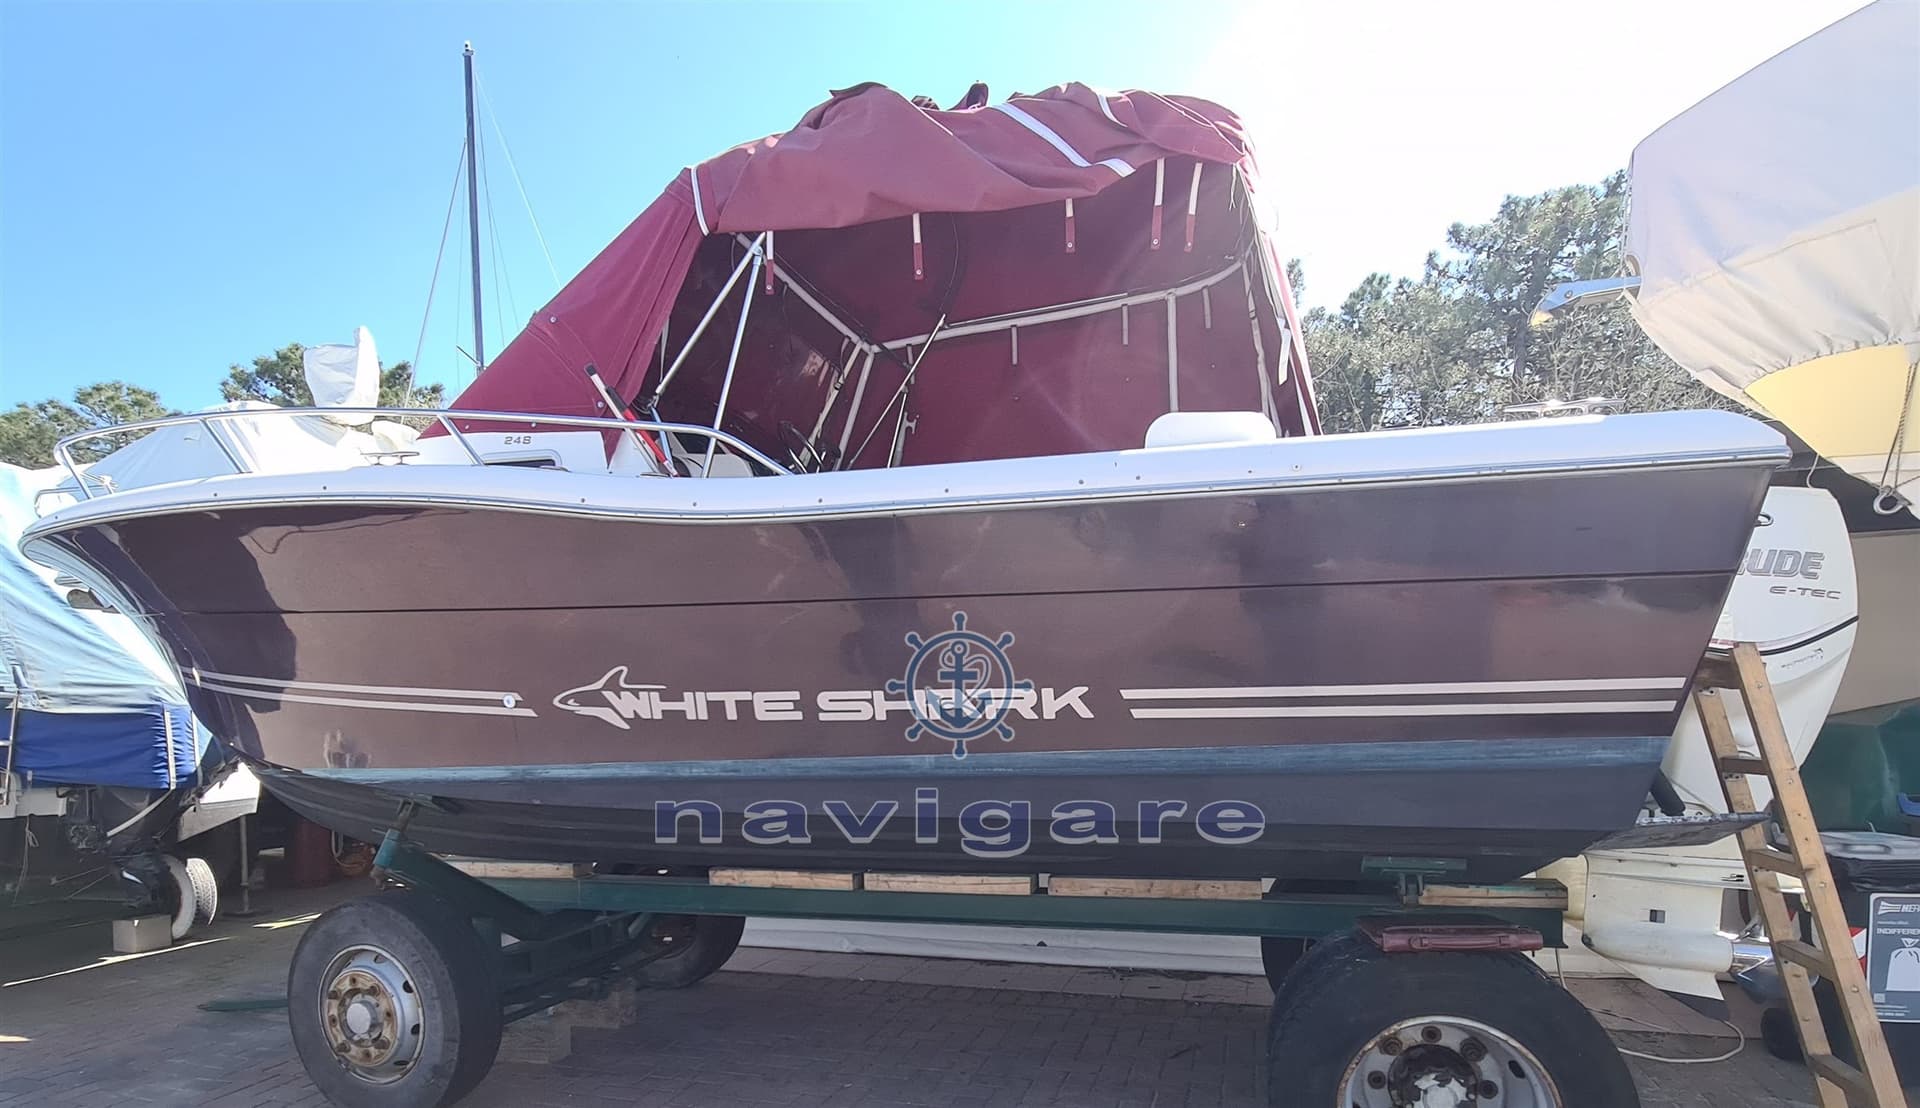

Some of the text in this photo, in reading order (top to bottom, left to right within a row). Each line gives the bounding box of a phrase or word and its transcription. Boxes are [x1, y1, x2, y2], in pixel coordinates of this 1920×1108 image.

[1769, 586, 1842, 600] E-TEC
[600, 686, 1096, 722] WHITE SHARK
